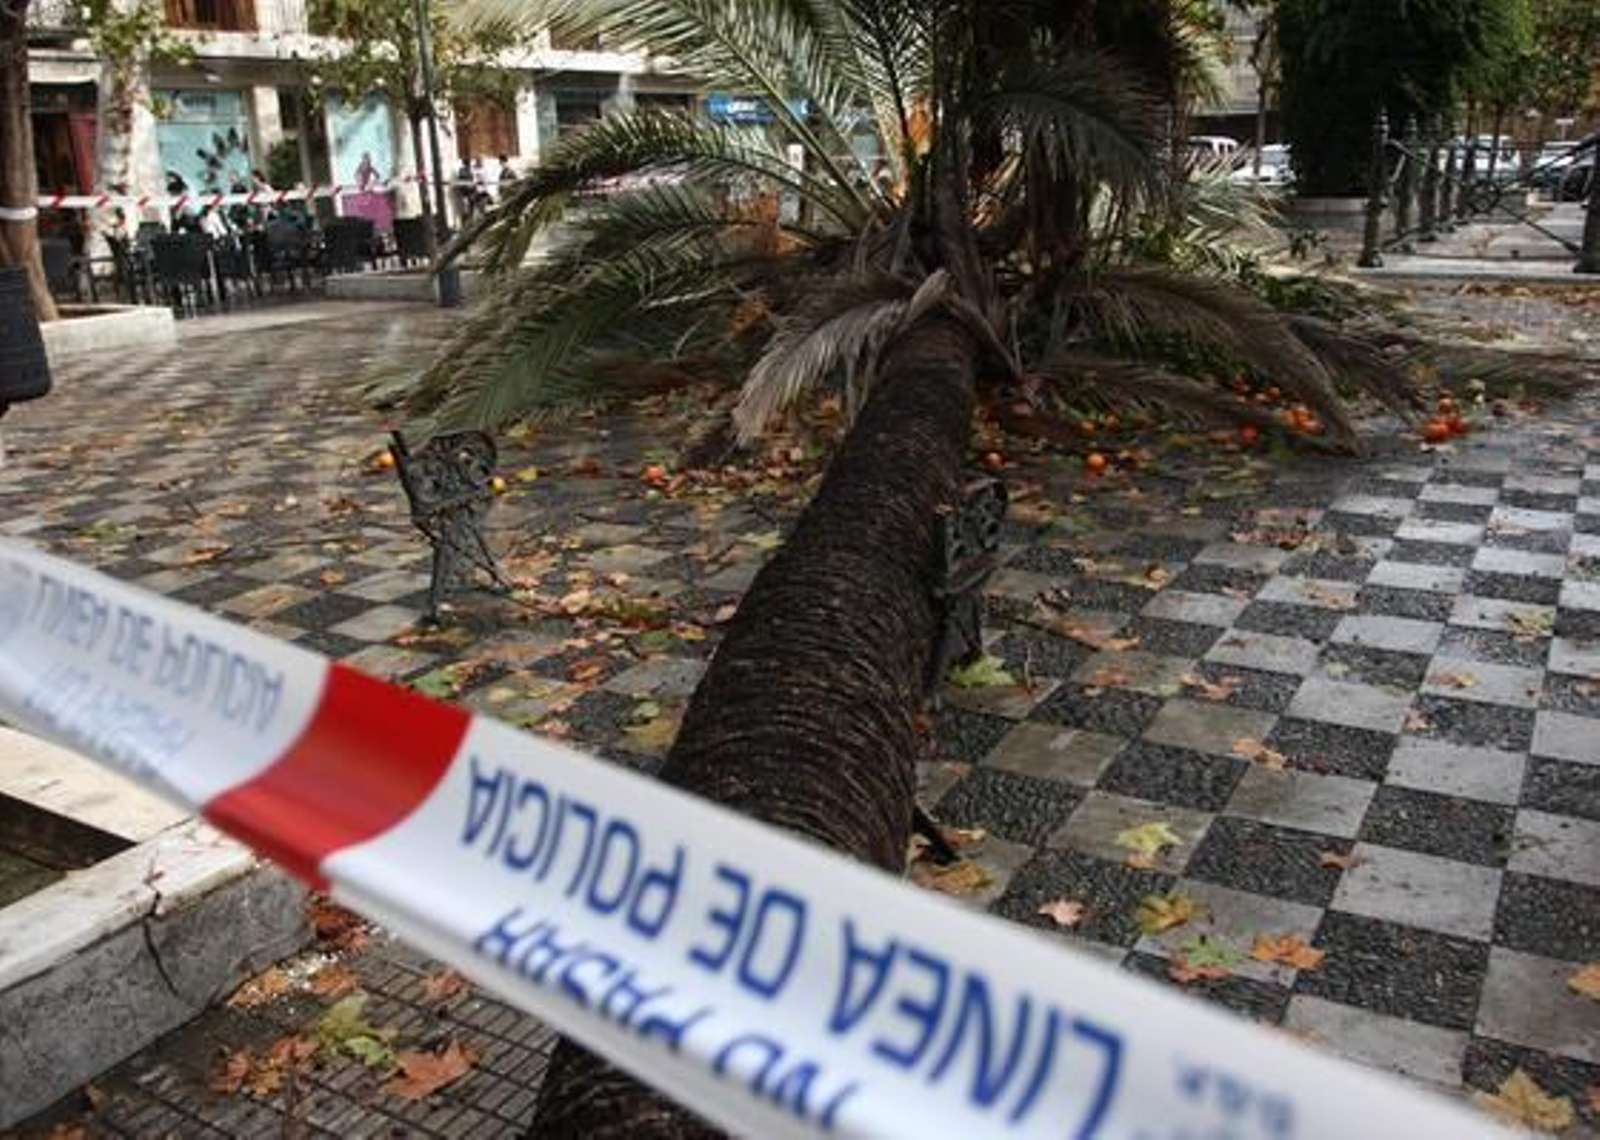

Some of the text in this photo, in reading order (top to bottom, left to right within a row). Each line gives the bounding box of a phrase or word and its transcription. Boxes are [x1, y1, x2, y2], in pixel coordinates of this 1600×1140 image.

[460, 755, 1126, 1140] LINEA DE POLICIA
